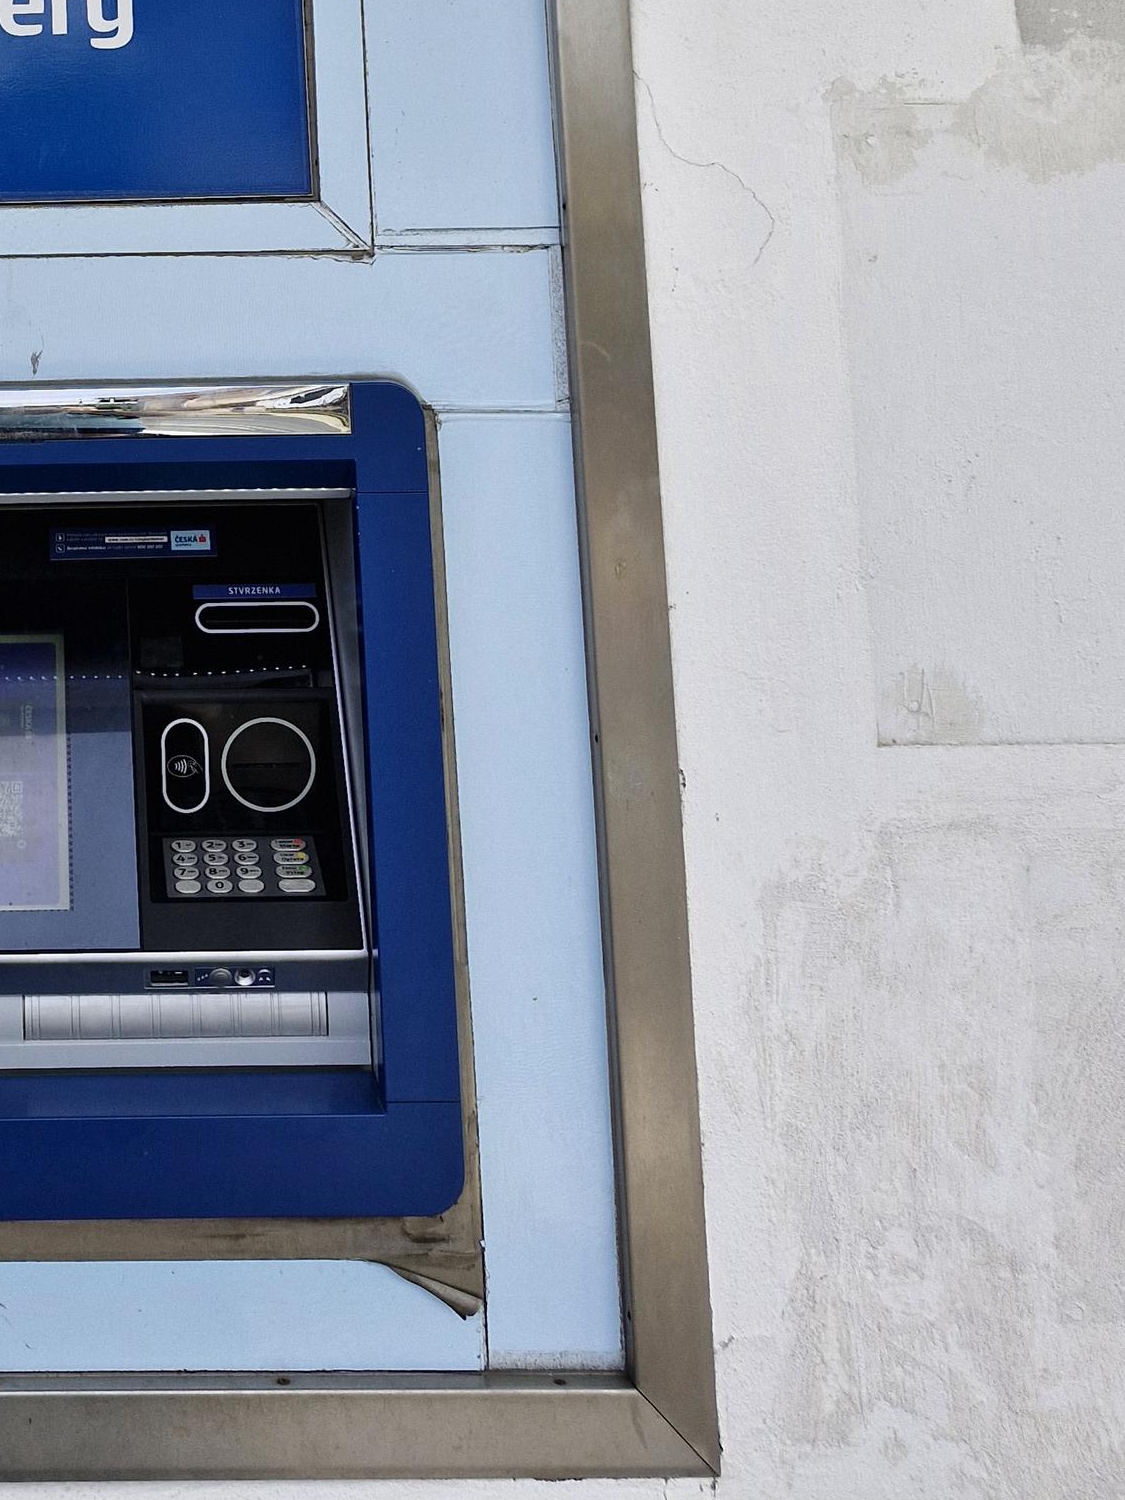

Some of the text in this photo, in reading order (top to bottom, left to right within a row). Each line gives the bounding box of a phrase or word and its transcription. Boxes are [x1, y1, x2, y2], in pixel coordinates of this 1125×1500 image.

[174, 533, 198, 543] ČESKÁ
[228, 586, 281, 595] STVRZENKA
[206, 841, 214, 849] 2
[238, 853, 247, 861] 6
